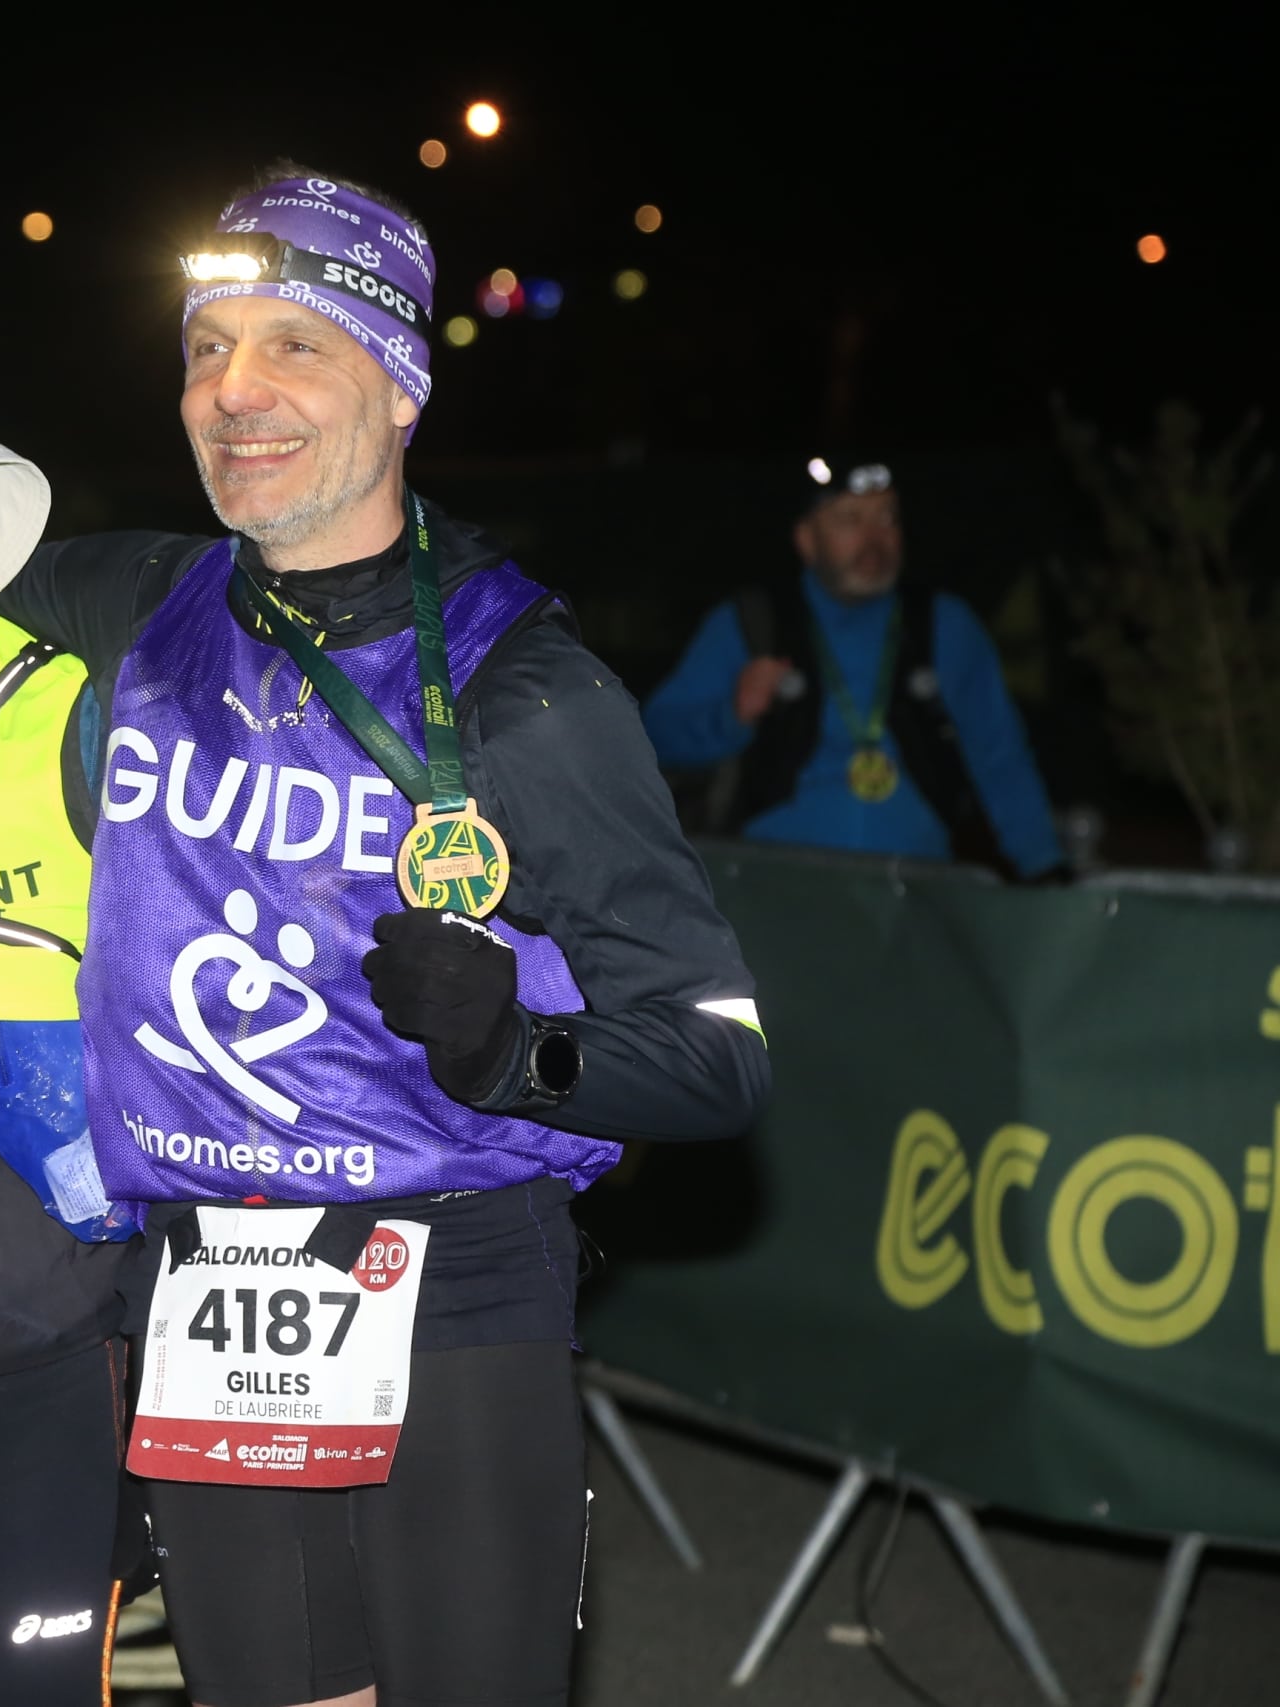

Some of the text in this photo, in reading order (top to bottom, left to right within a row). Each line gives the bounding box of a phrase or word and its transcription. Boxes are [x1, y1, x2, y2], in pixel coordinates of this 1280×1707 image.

[262, 197, 361, 225] binomes
[380, 224, 433, 285] binomes
[278, 282, 370, 346] binomes
[384, 350, 426, 407] binom
[102, 726, 393, 873] GUIDE
[359, 1240, 407, 1271] 120
[369, 1273, 387, 1285] KM
[187, 1288, 361, 1357] 4187
[226, 1370, 311, 1397] GILLES
[214, 1400, 323, 1420] DE LAUBRIÈRE
[271, 1434, 309, 1443] SALOMON
[236, 1443, 307, 1463] ecotrail
[242, 1461, 305, 1472] PARIS PRINTEMPS
